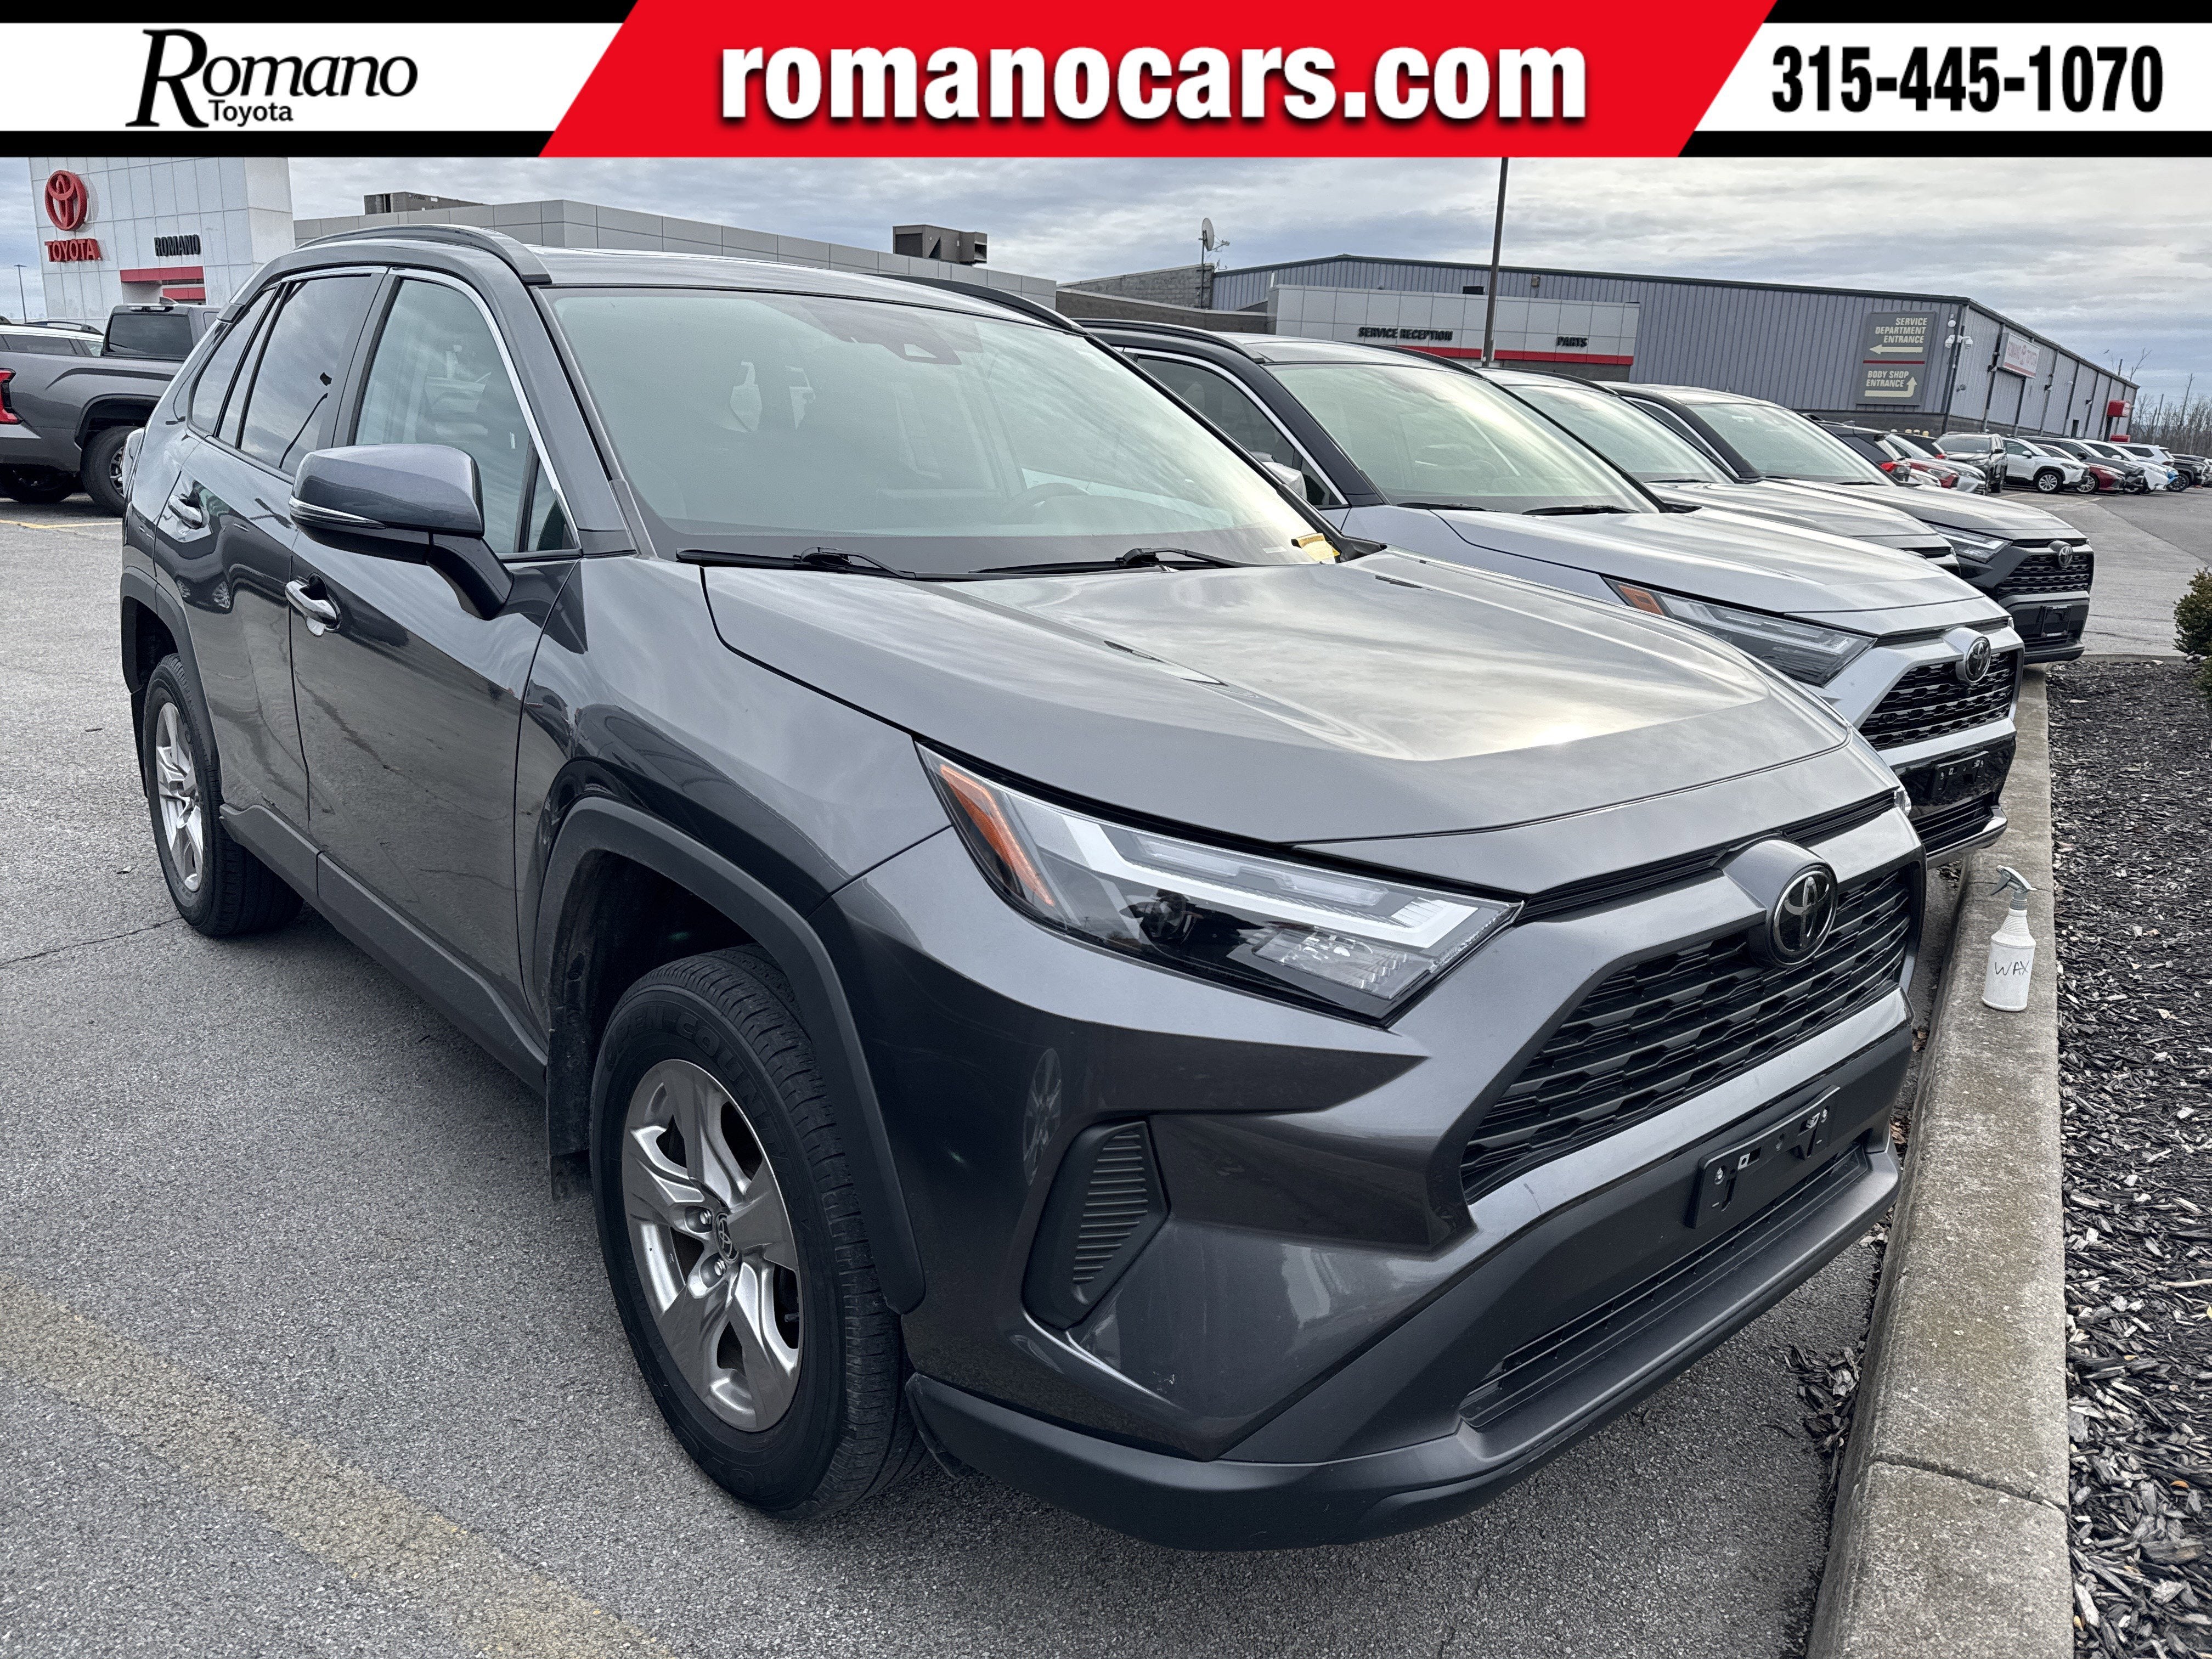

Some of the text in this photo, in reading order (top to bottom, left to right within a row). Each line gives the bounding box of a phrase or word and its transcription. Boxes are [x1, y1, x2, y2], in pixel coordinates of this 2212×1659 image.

[44, 238, 99, 262] TOYOTA
[154, 234, 201, 256] ROMANO
[1895, 317, 1928, 325] SERVICE
[1358, 326, 1453, 341] SERVICE RECEPTION
[1883, 335, 1924, 343] ENTRANCE
[1556, 336, 1588, 348] PARTS
[1867, 370, 1909, 379] BODY SHOP
[1866, 379, 1905, 387] ENTRANCE
[1995, 961, 2030, 976] WAX
